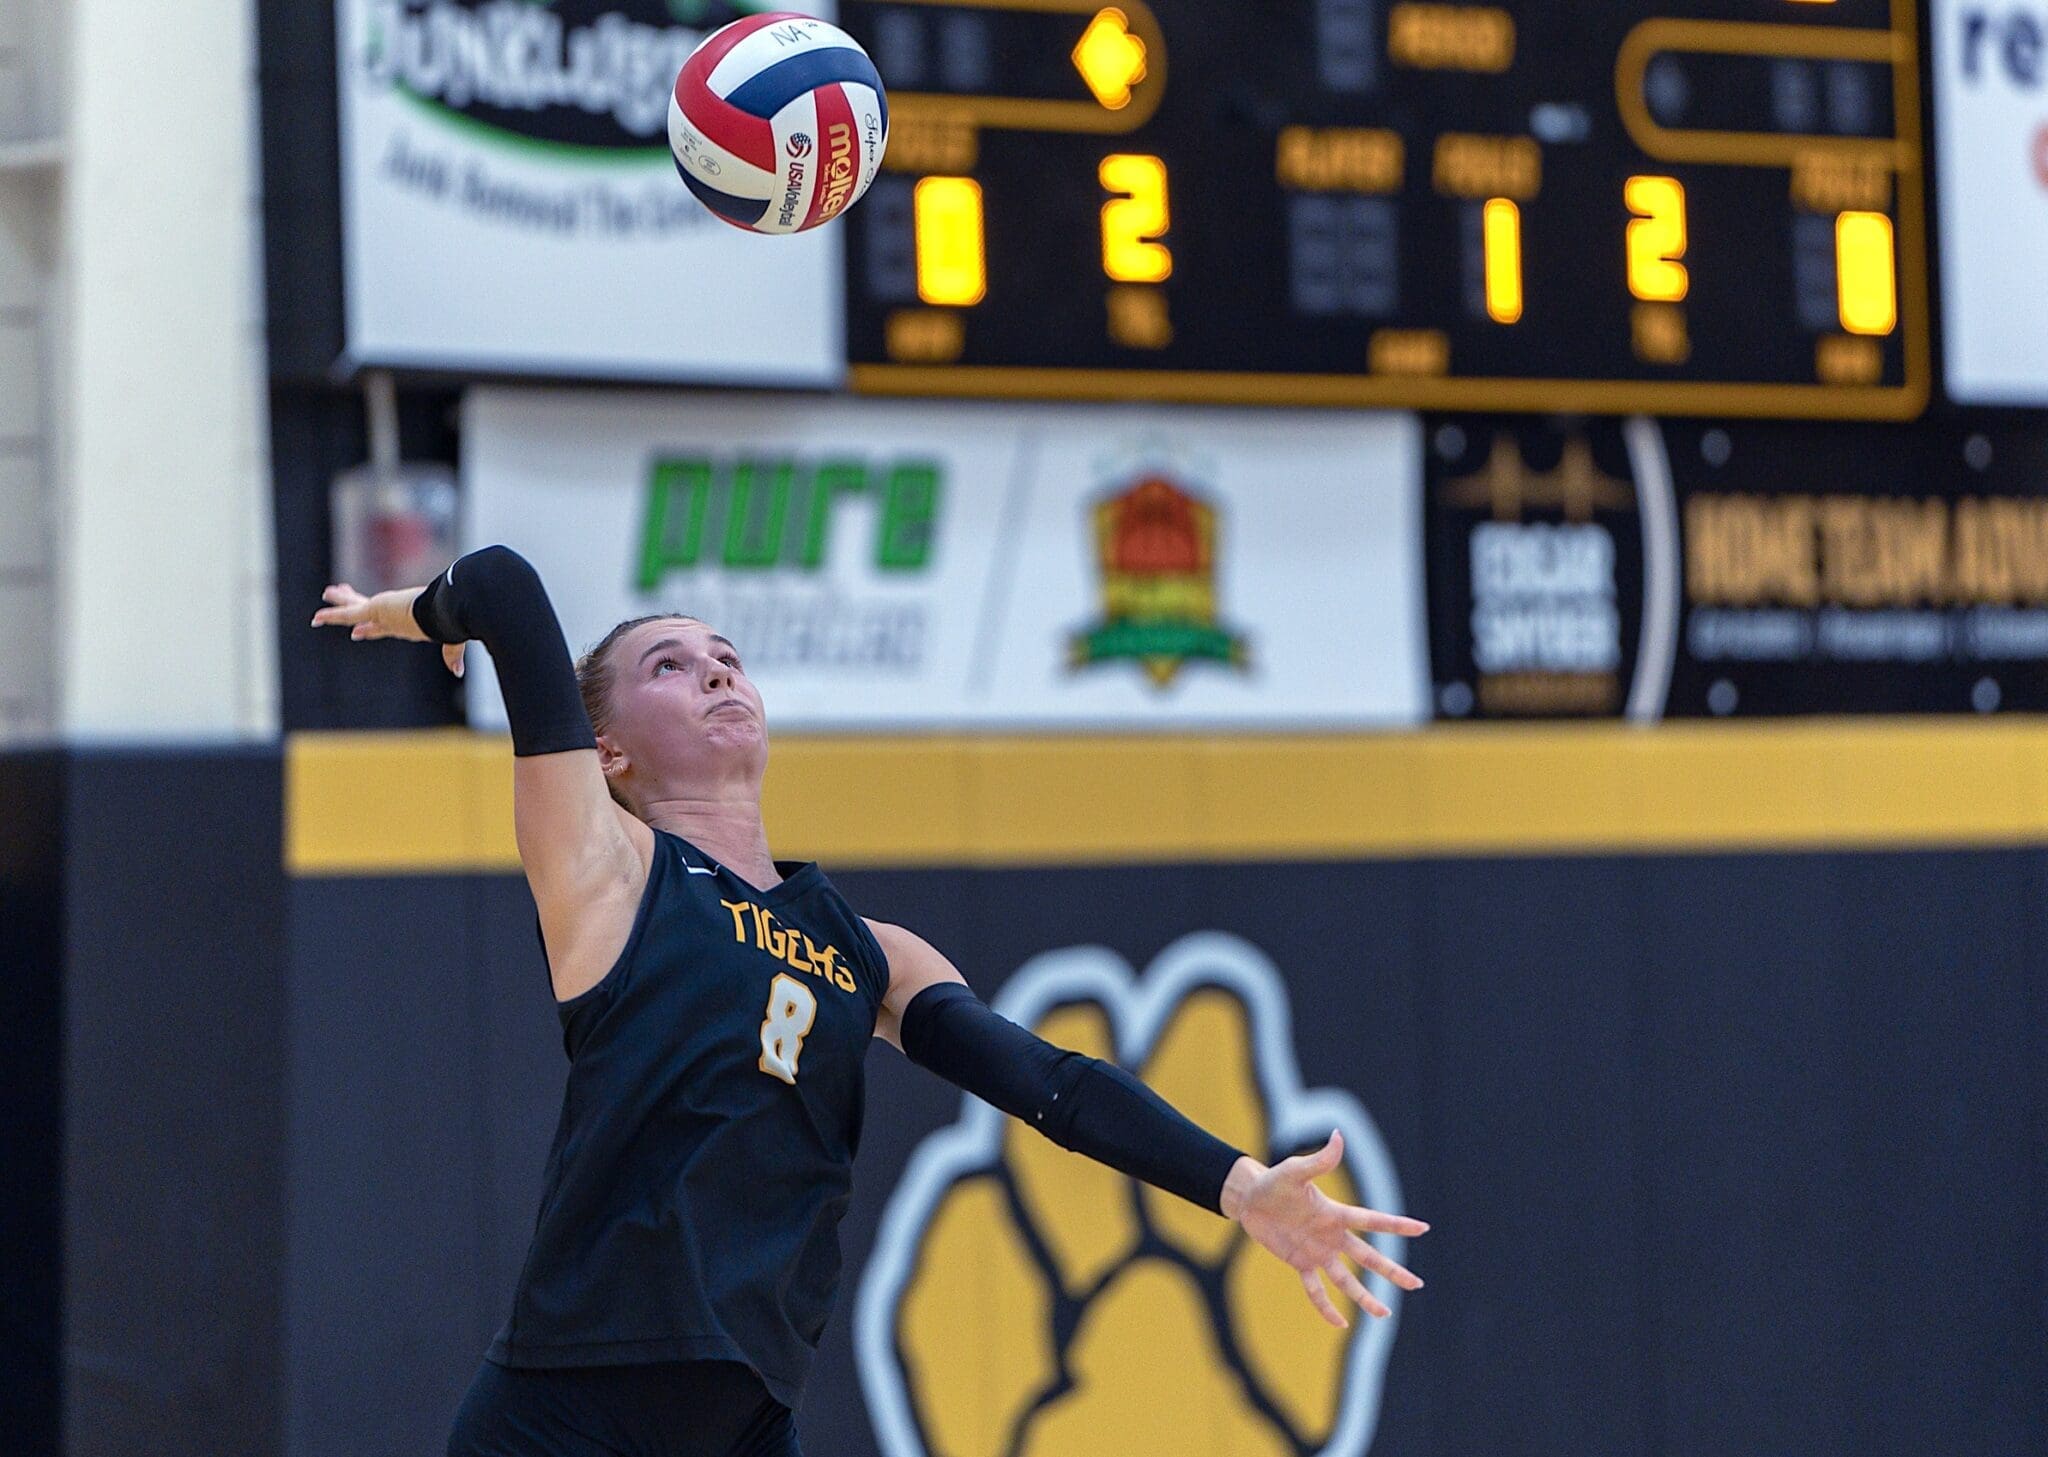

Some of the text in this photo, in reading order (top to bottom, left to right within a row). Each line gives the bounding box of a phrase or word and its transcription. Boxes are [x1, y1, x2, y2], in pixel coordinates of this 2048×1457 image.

[814, 121, 854, 224] molten
[1100, 155, 1171, 282] 2
[1484, 198, 1522, 322] 1
[1625, 176, 1688, 301] 2
[633, 454, 945, 594] pure
[720, 898, 857, 994] TIGERS
[758, 972, 818, 1086] 8
